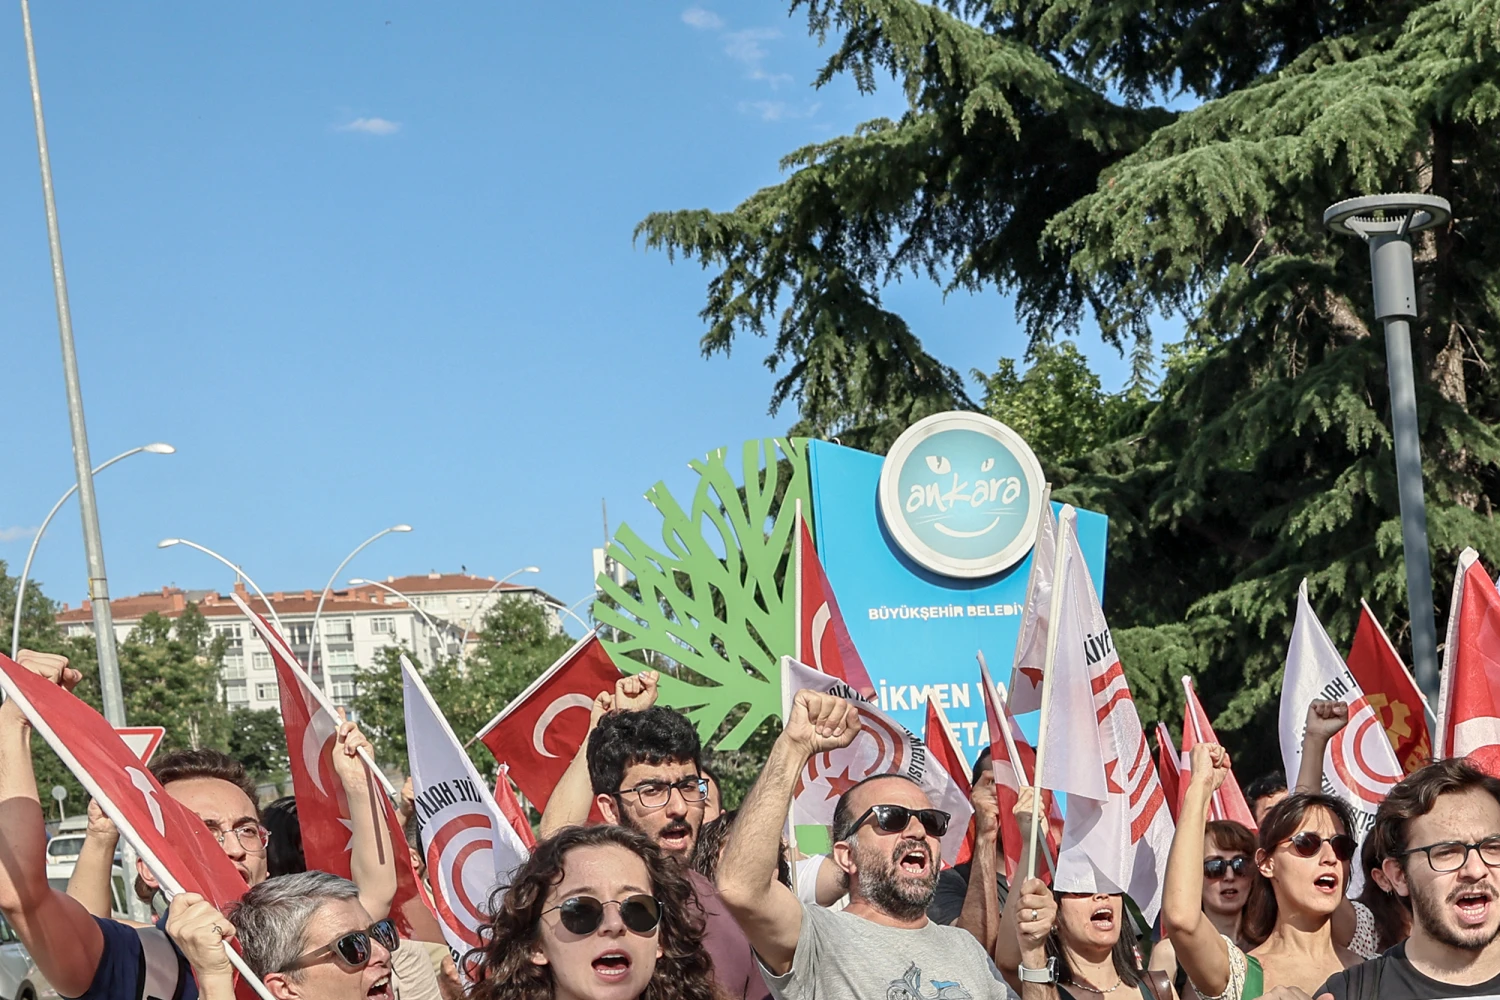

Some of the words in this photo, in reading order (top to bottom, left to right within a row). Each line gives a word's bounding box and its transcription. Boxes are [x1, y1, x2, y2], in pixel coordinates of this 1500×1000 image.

[906, 472, 1021, 513] ankara
[868, 602, 964, 620] BÜYÜKŞEHİR
[876, 679, 970, 712] İKMEN
